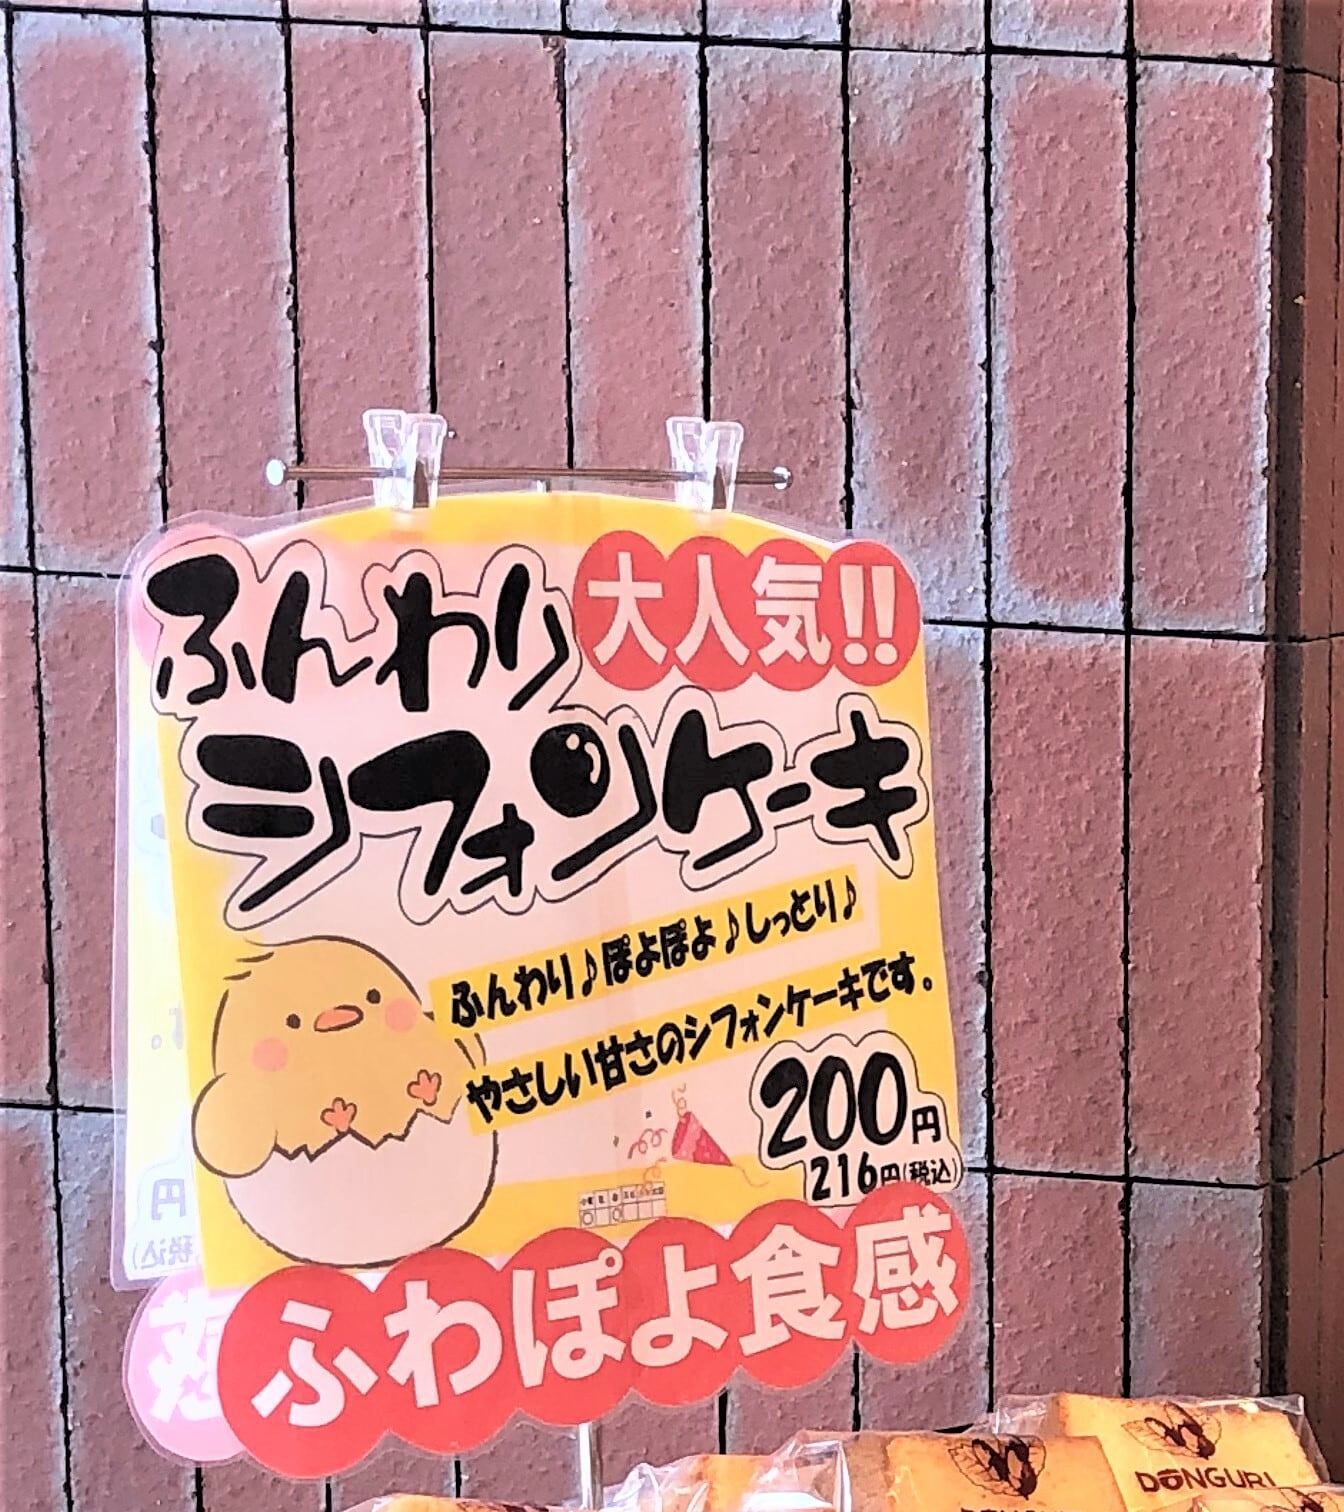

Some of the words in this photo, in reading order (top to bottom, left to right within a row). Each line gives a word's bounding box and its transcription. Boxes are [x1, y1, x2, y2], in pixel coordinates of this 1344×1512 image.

[146, 553, 570, 713] ふんわり
[587, 556, 900, 667] 大人気!!
[198, 709, 919, 913] シフォンケーキ
[760, 1052, 941, 1158] 200円
[252, 1200, 960, 1430] ふわぽよ食感
